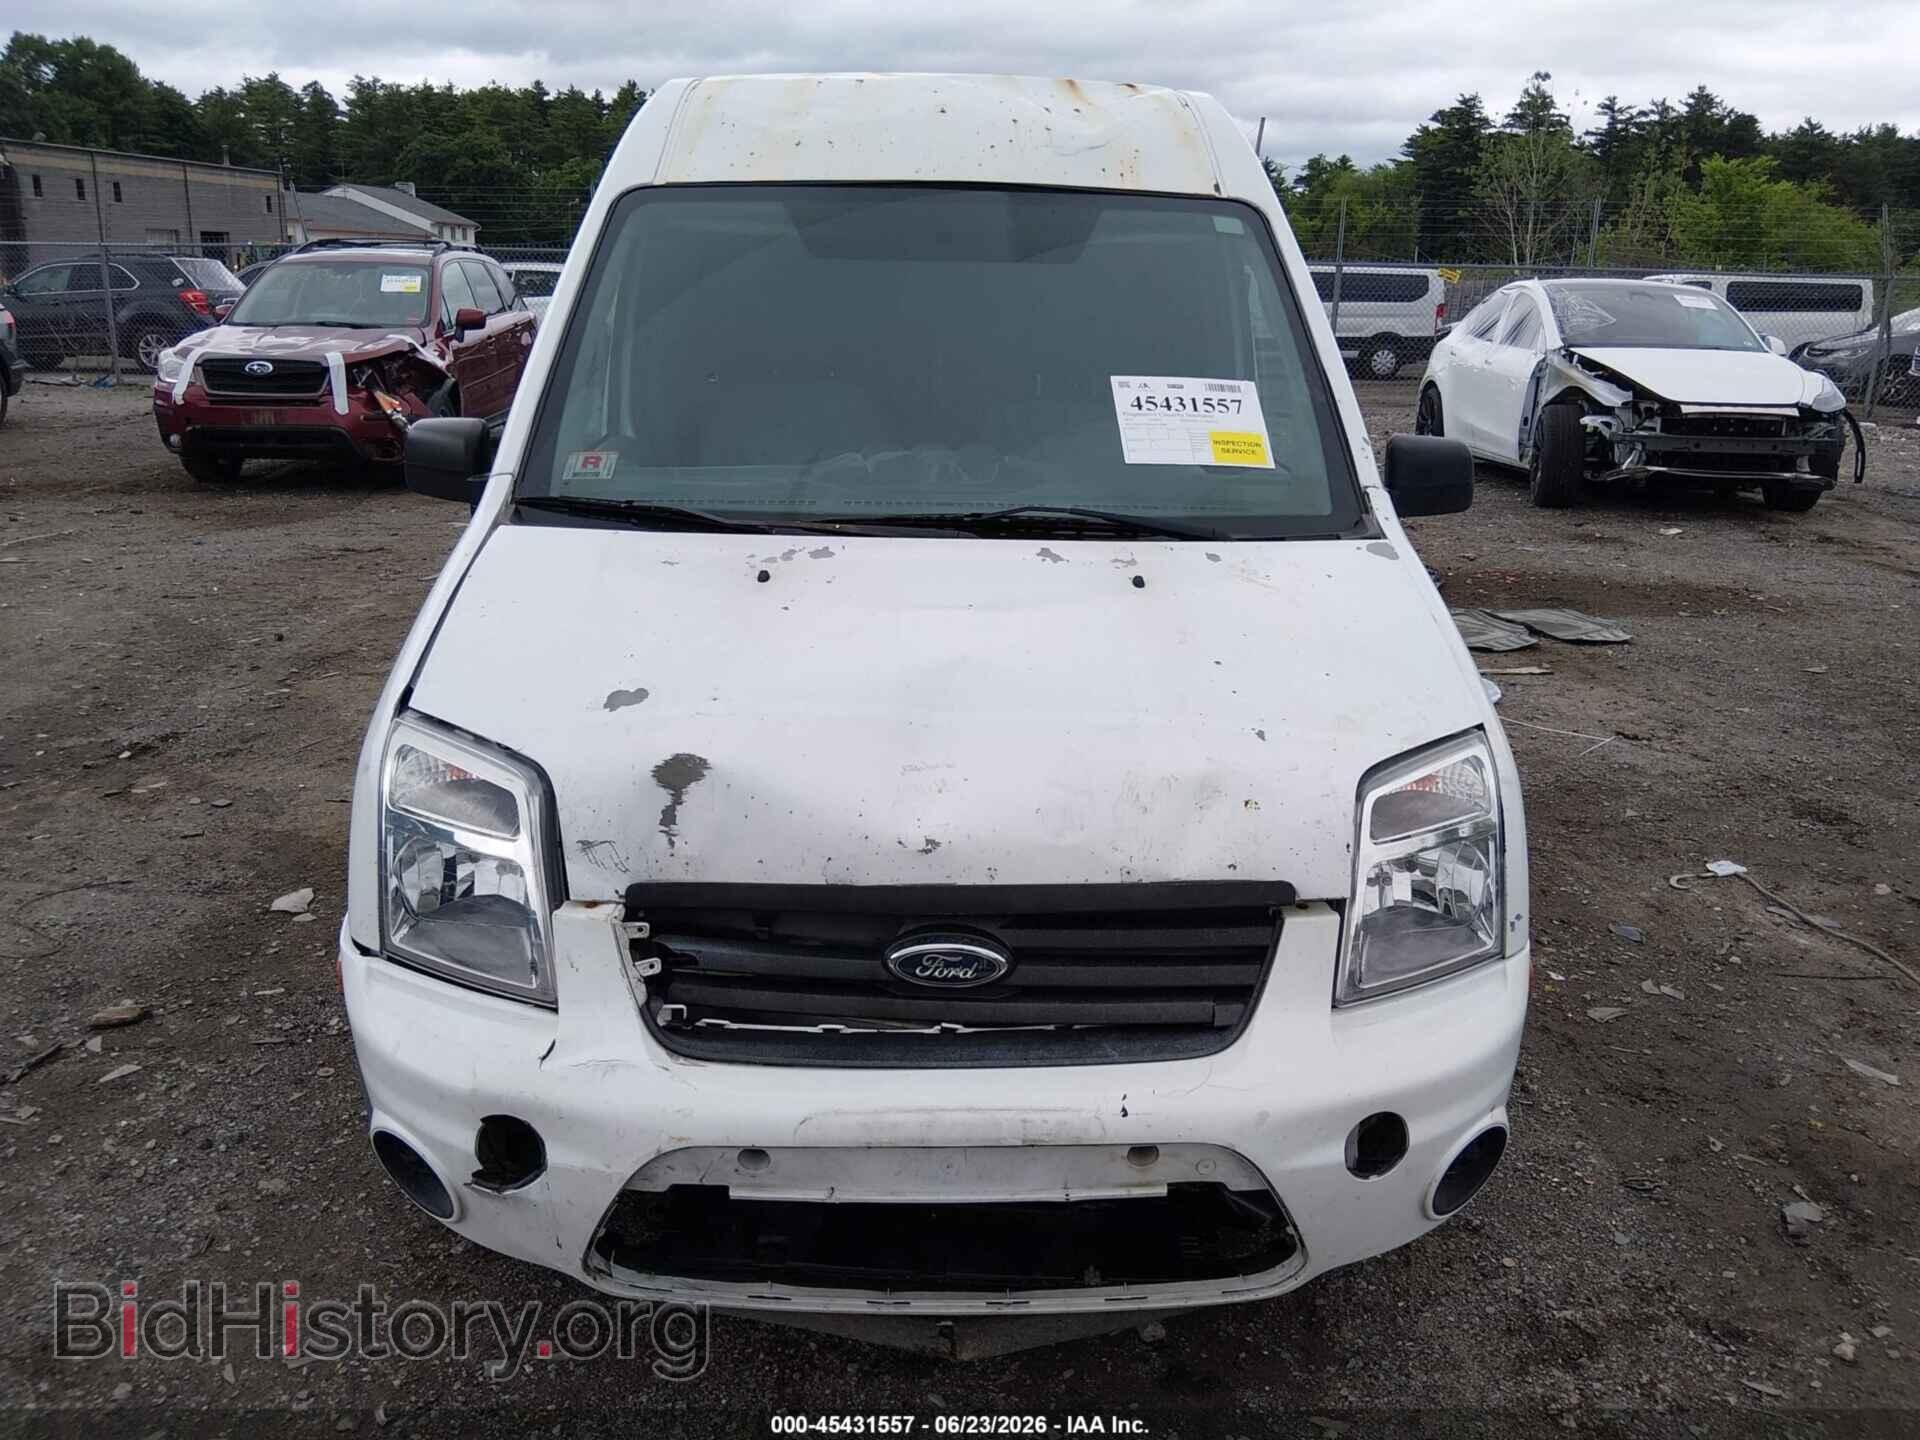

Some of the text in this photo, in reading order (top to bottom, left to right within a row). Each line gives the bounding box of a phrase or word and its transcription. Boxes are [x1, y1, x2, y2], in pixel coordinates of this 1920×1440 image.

[1130, 395, 1242, 415] 45431557
[1212, 439, 1262, 449] INSPECTION
[1220, 447, 1257, 456] SERVICE
[581, 455, 602, 469] R
[915, 953, 978, 979] Ford
